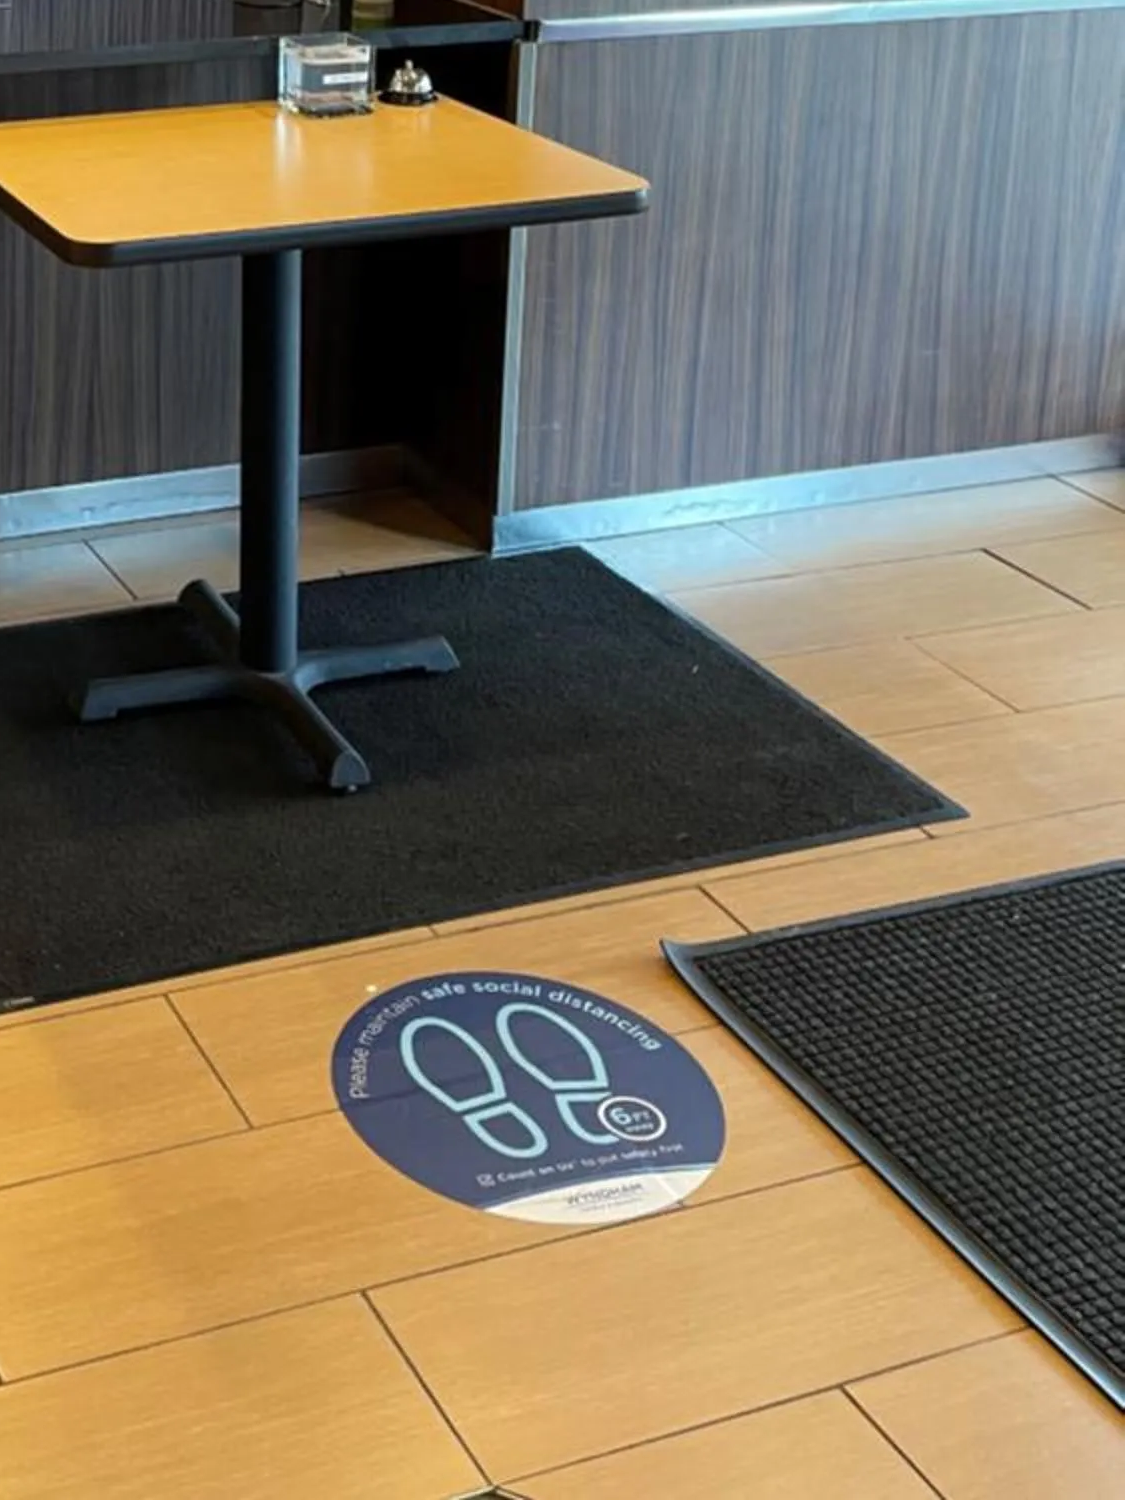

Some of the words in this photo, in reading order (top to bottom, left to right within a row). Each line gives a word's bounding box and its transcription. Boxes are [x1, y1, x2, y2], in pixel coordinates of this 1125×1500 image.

[358, 995, 421, 1046] maintain
[420, 982, 466, 1000] safe
[472, 981, 542, 997] social
[548, 990, 663, 1051] distancing
[610, 1107, 632, 1125] 6
